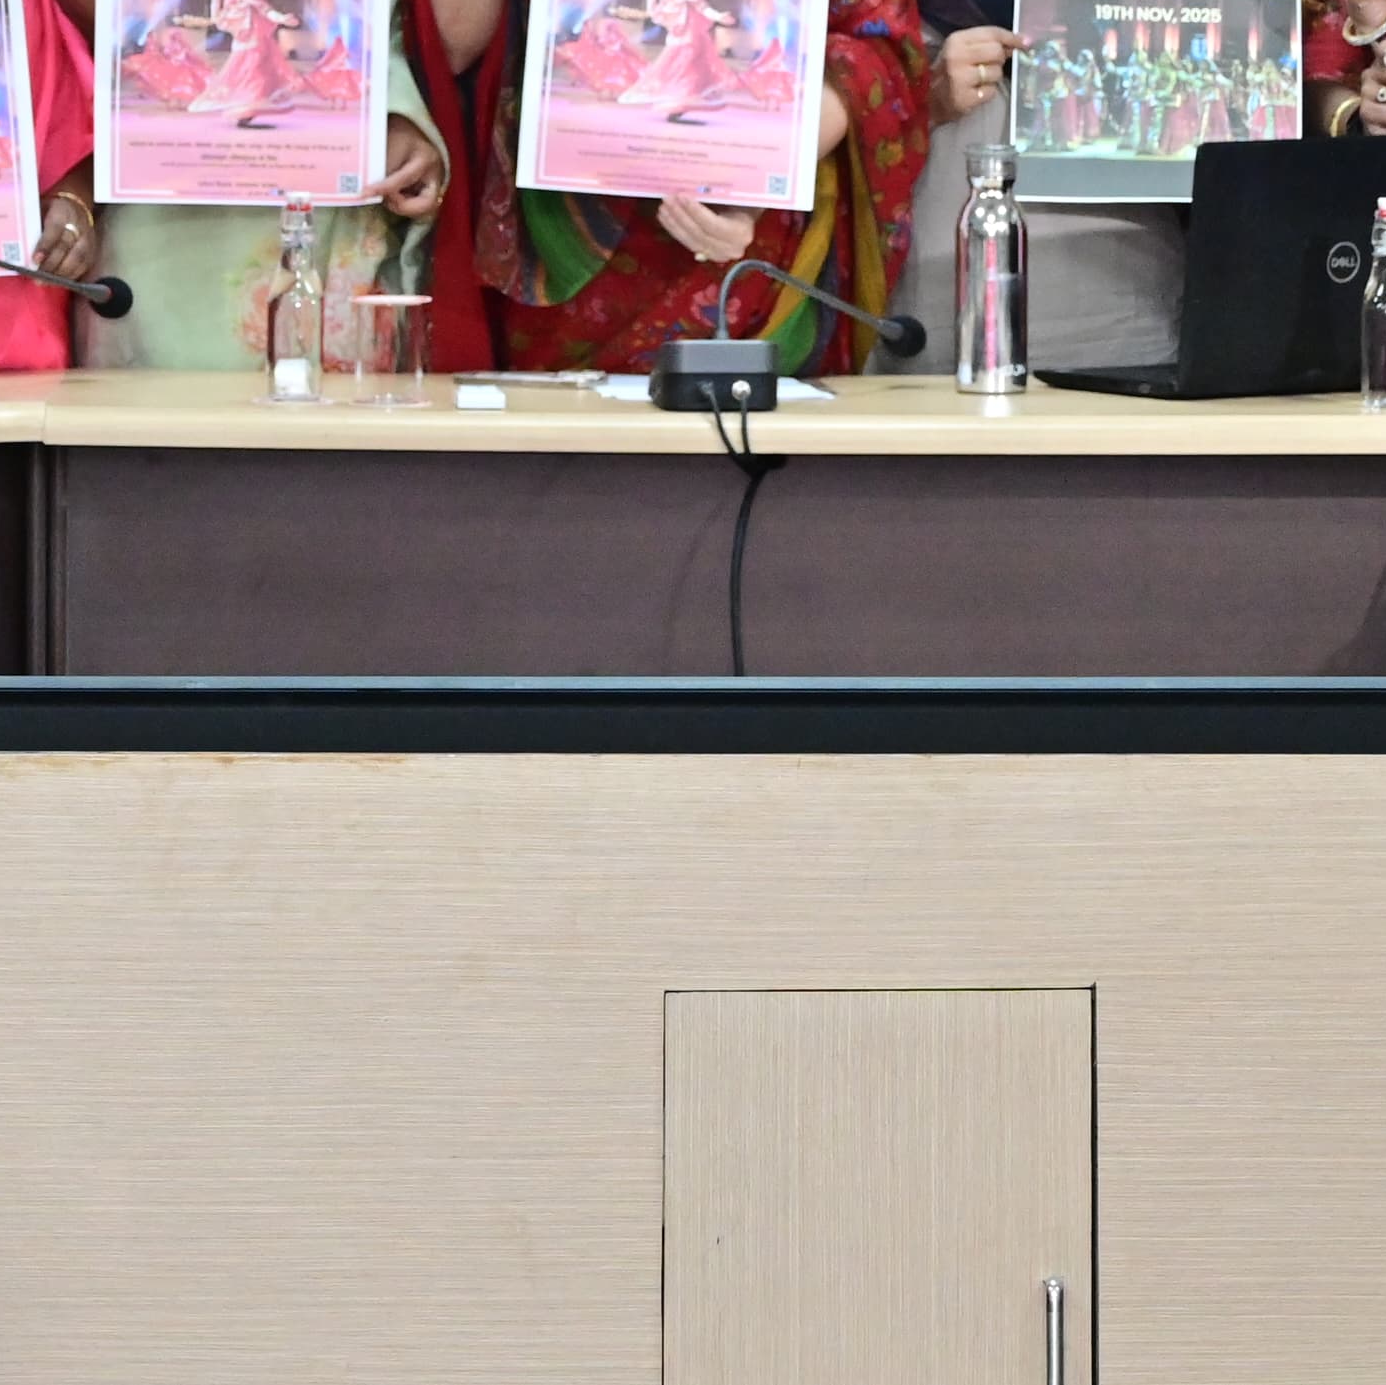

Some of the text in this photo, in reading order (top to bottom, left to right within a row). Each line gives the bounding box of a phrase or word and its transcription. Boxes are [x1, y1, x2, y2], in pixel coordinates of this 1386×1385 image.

[1095, 4, 1222, 24] 19TH NOV, 2025
